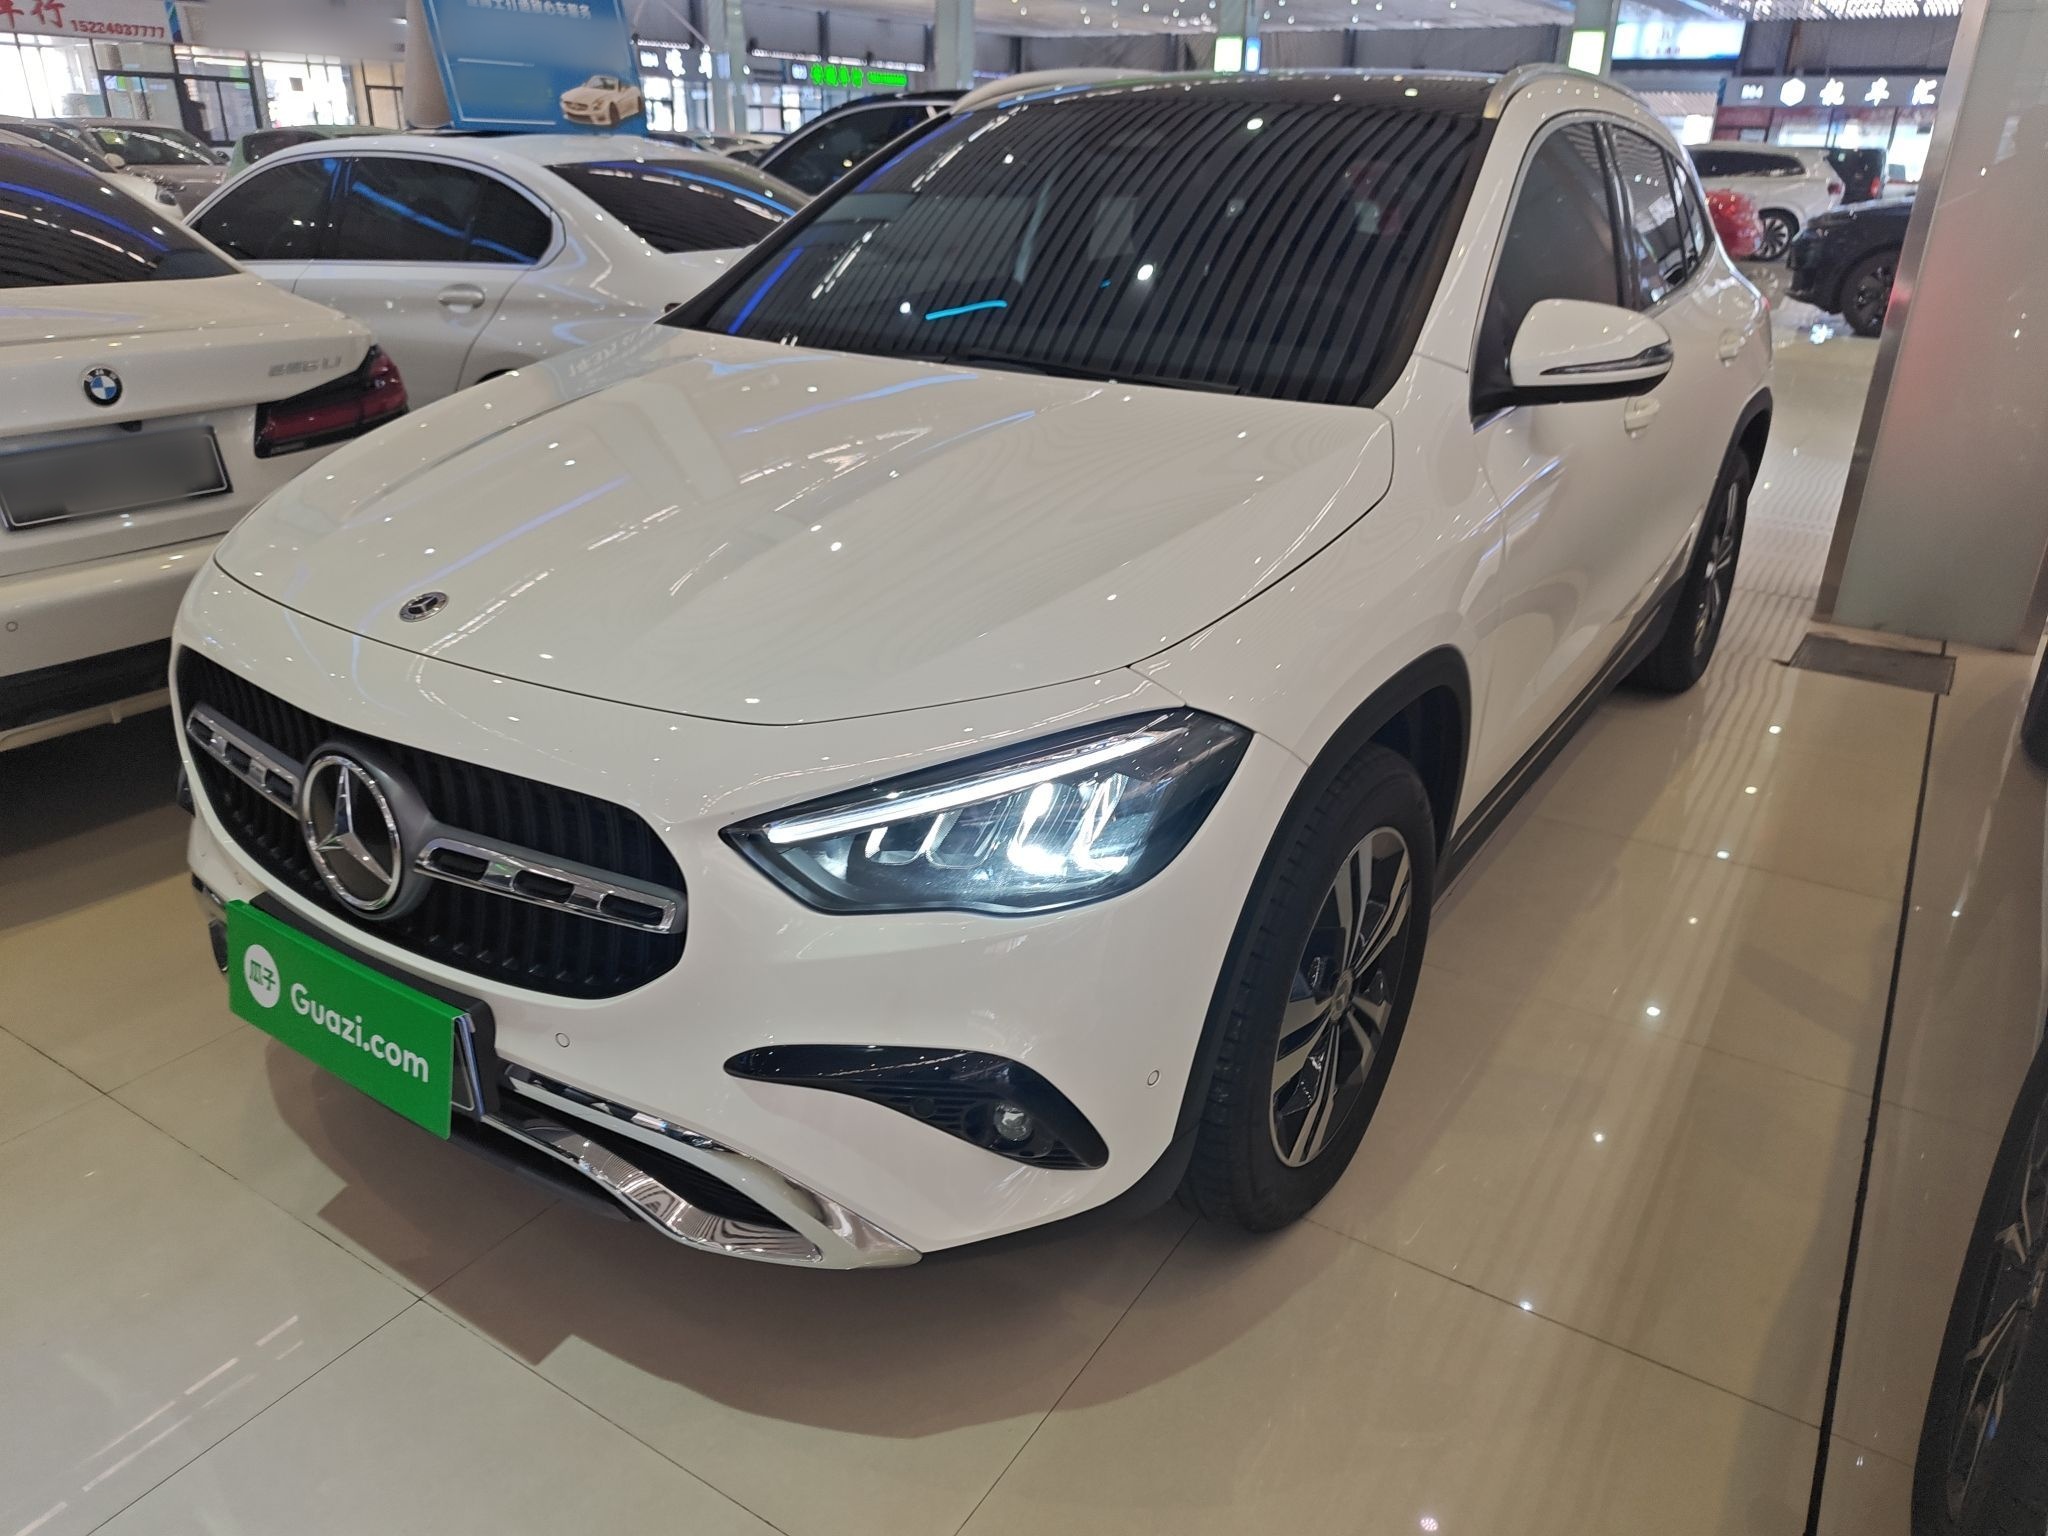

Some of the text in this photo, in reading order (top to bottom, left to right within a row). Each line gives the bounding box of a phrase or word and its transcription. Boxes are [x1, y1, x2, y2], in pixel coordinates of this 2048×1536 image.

[71, 20, 164, 38] 15224037777
[249, 959, 276, 991] 瓜子
[290, 982, 429, 1083] Guazi.com
